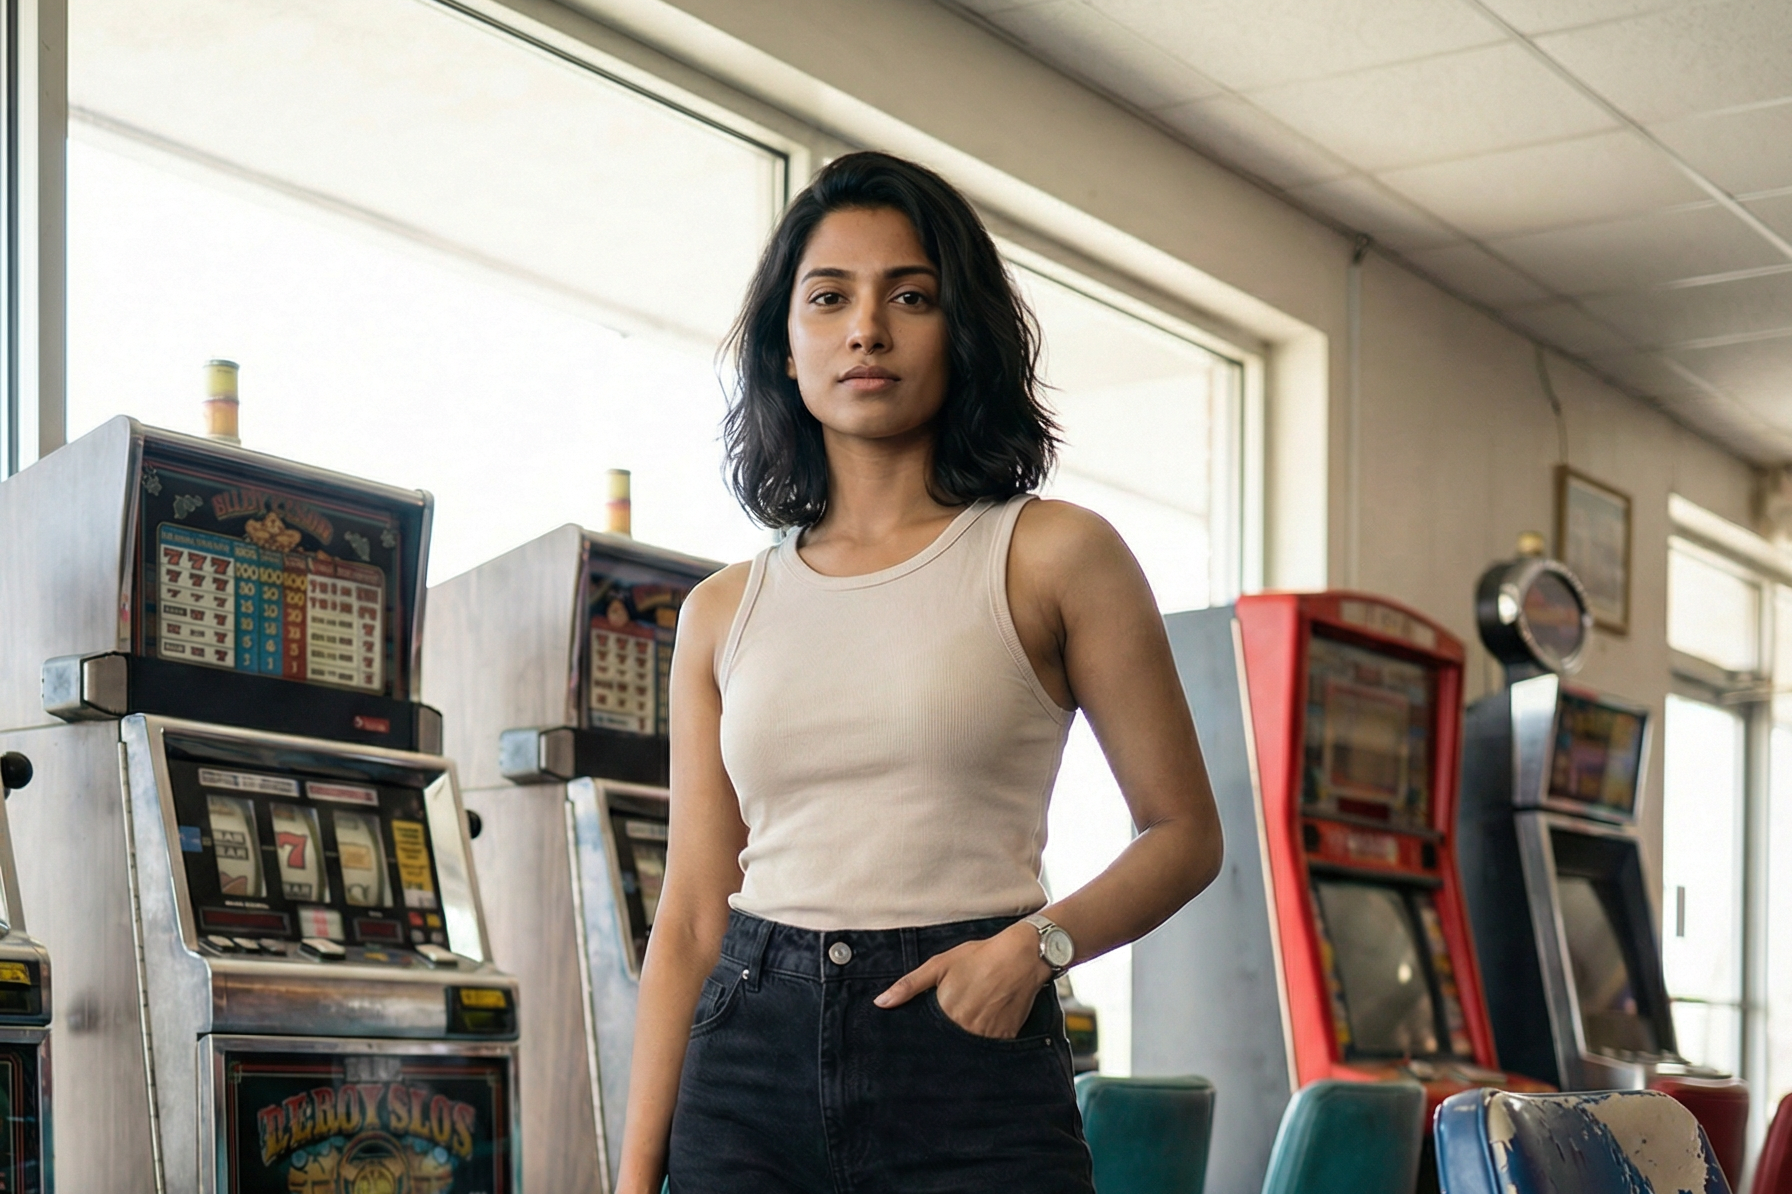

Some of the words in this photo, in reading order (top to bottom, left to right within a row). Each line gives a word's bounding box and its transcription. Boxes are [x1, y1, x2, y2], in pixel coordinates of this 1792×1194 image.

[163, 547, 184, 566] 7
[187, 551, 207, 571] 7
[210, 556, 231, 575] 7
[166, 568, 182, 583] 7
[189, 572, 206, 587] 7
[212, 576, 229, 592] 7
[276, 831, 308, 870] 7
